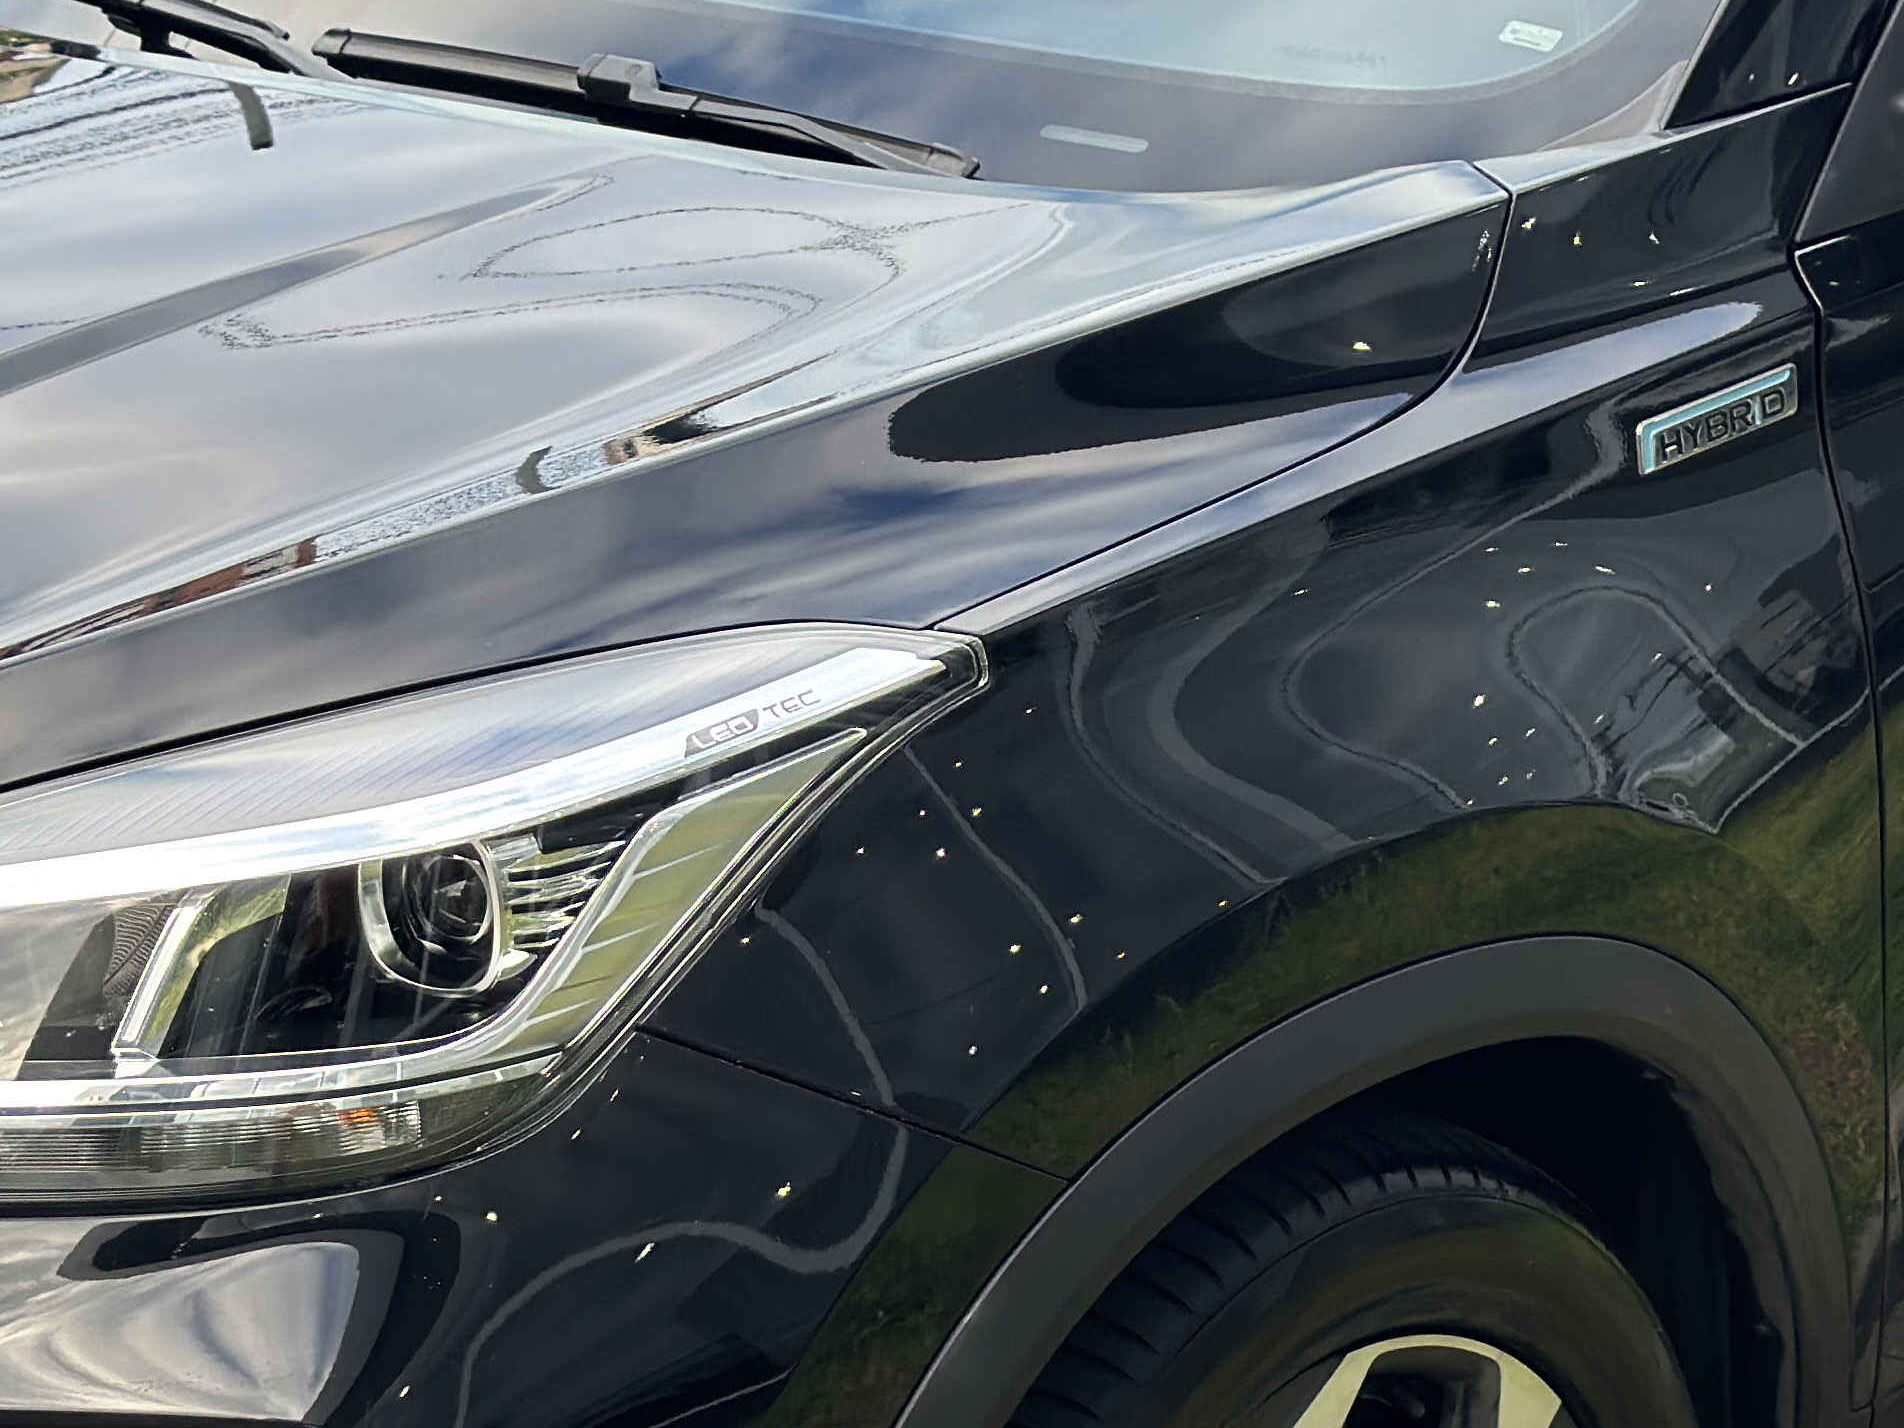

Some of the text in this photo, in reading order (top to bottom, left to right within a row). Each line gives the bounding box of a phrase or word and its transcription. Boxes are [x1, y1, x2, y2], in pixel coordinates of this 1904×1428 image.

[1660, 385, 1787, 464] HYBRID
[691, 715, 754, 750] LED
[762, 688, 822, 719] TEC
